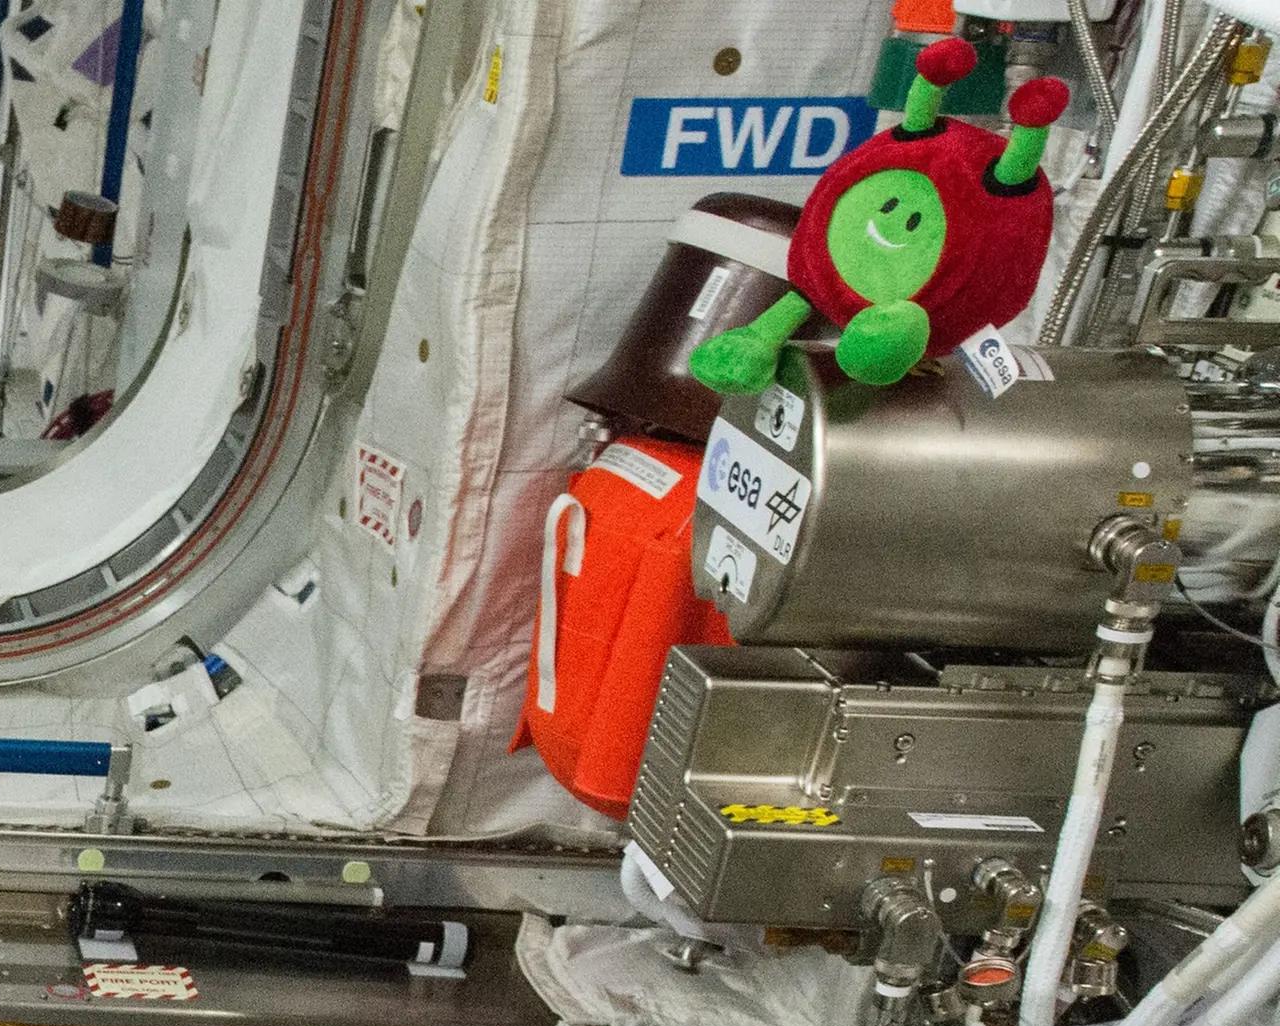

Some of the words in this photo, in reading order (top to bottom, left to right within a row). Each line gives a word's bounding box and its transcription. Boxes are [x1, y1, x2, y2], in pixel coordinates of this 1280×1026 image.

[661, 106, 850, 168] FWD
[993, 356, 1012, 386] esa
[728, 461, 761, 510] esa
[774, 534, 792, 560] DLR
[101, 977, 134, 985] FIRE
[138, 978, 178, 987] PORT
